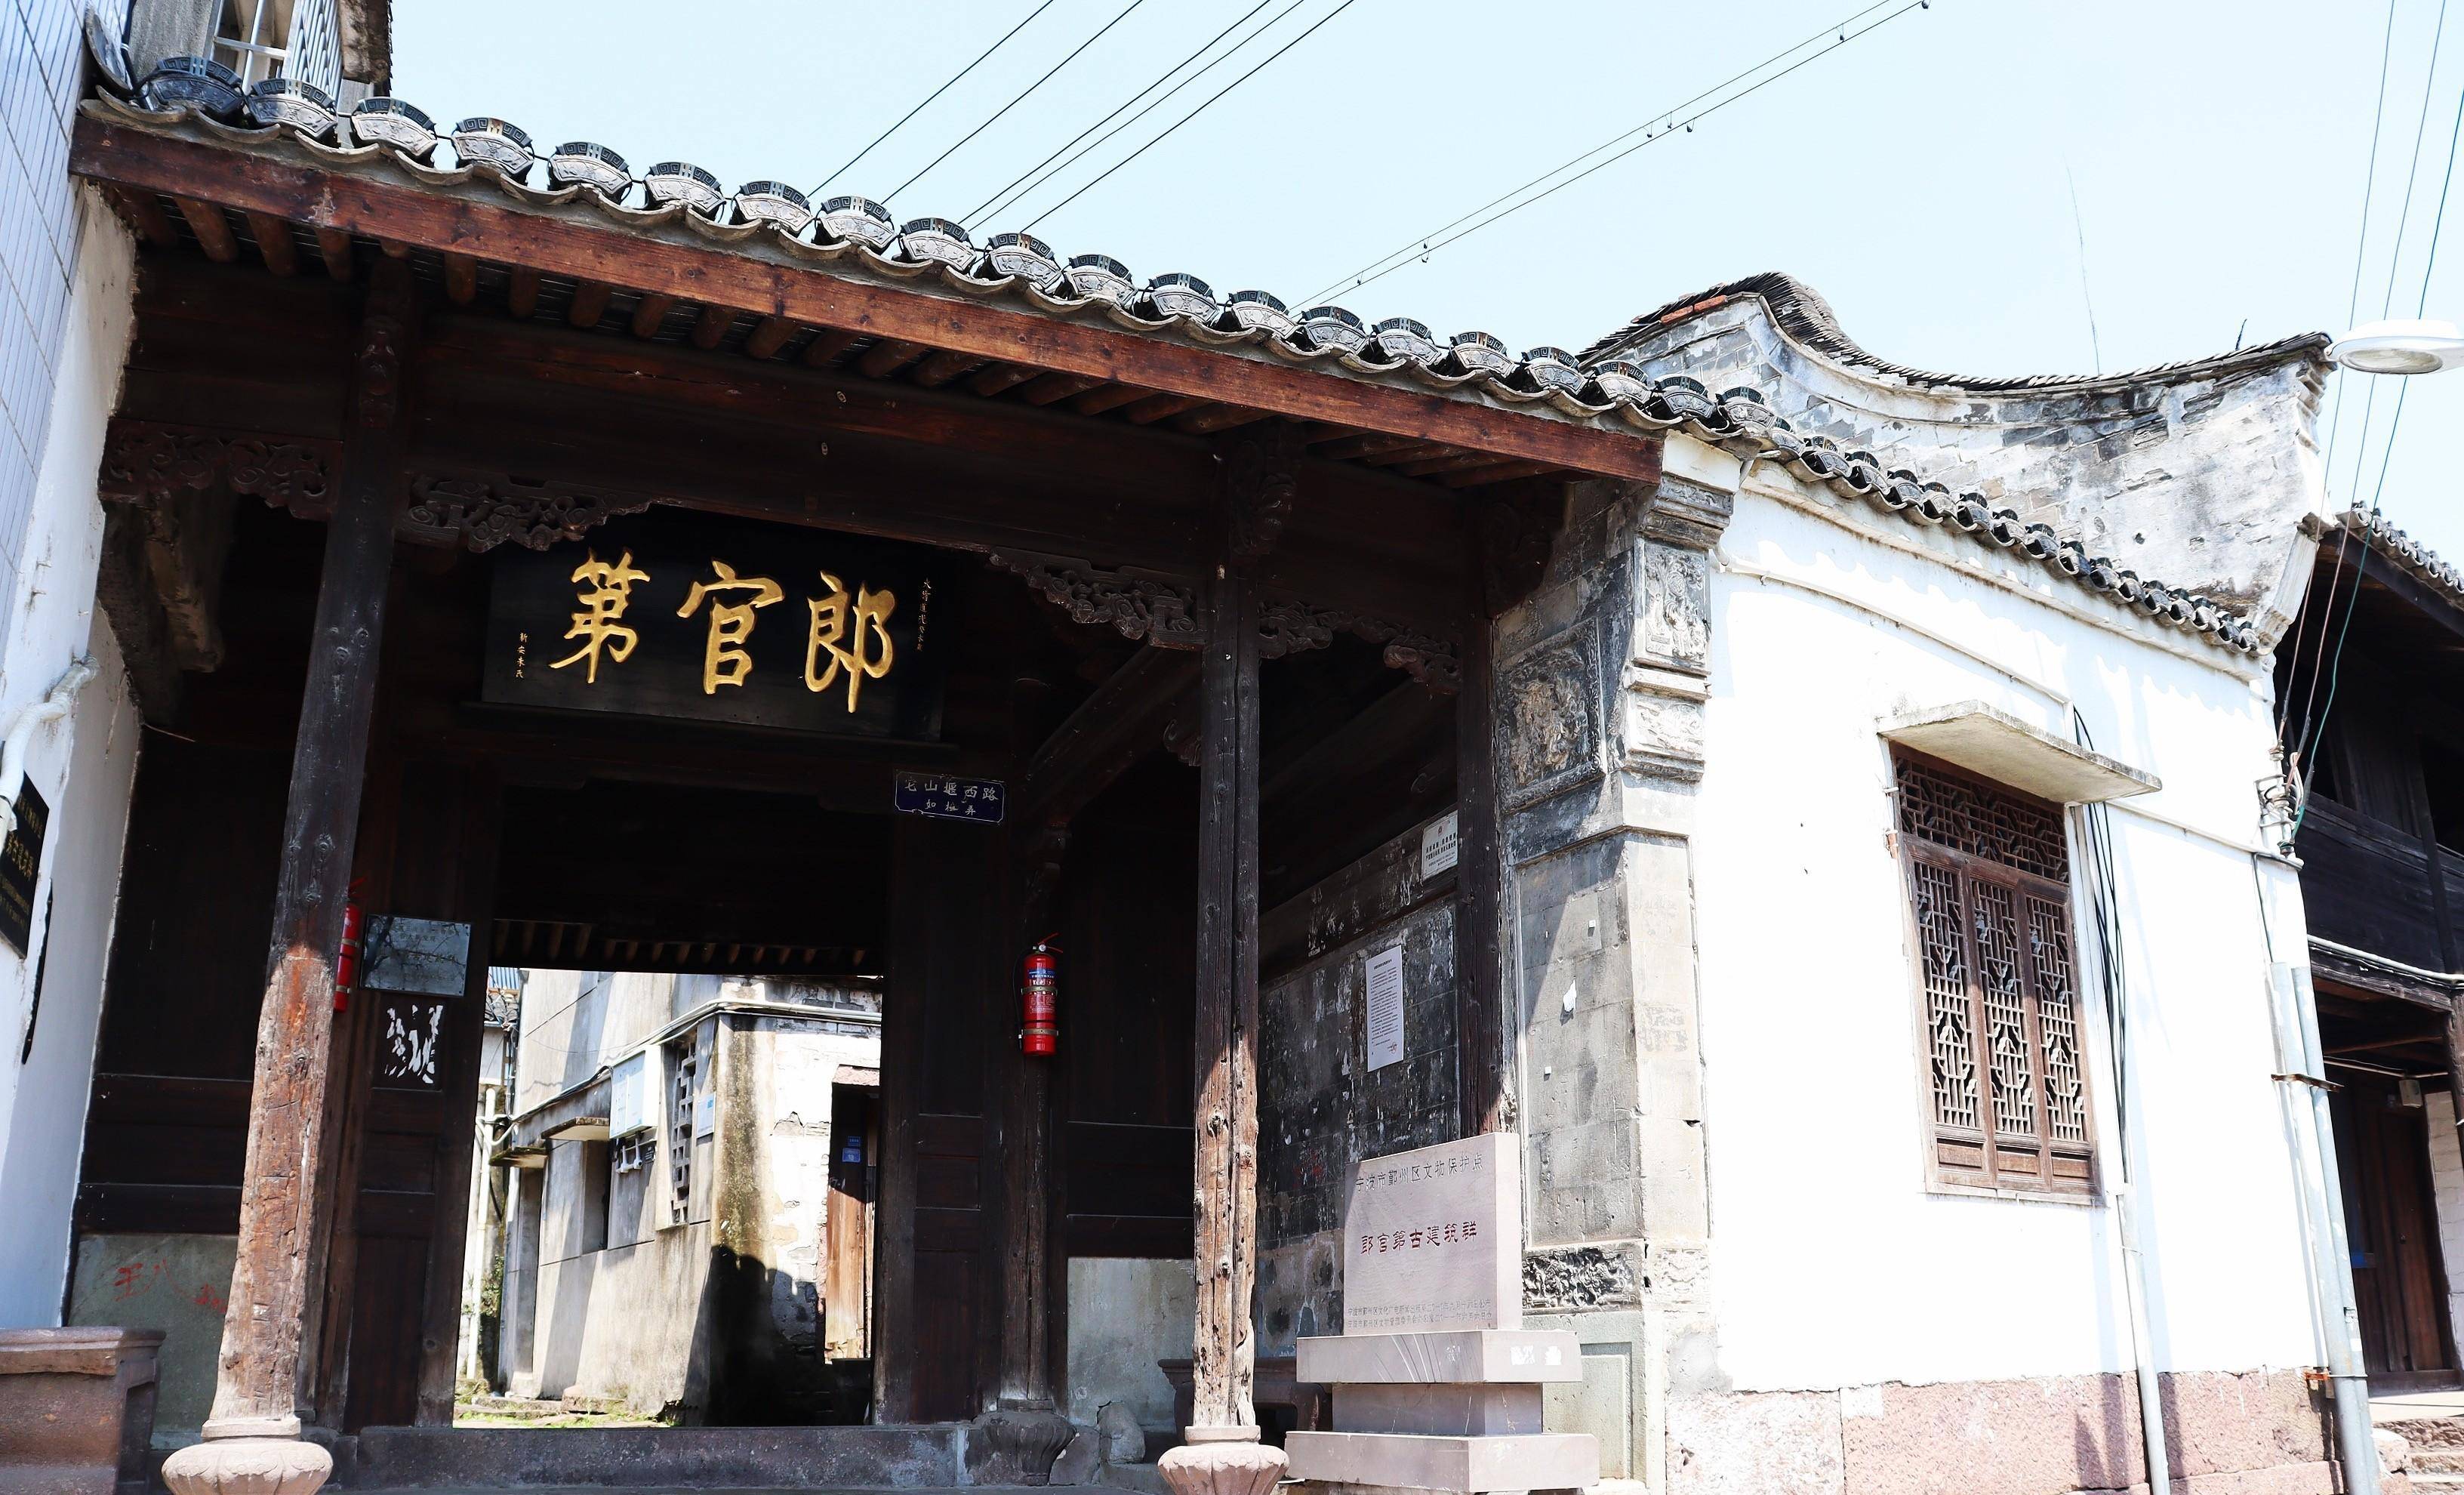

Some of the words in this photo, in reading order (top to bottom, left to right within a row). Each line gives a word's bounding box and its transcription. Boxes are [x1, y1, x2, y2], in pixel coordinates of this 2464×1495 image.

[1355, 1152, 1483, 1193] 宁波市鄞州区文物保护点
[1360, 1221, 1478, 1256] 郎官第古建筑群
